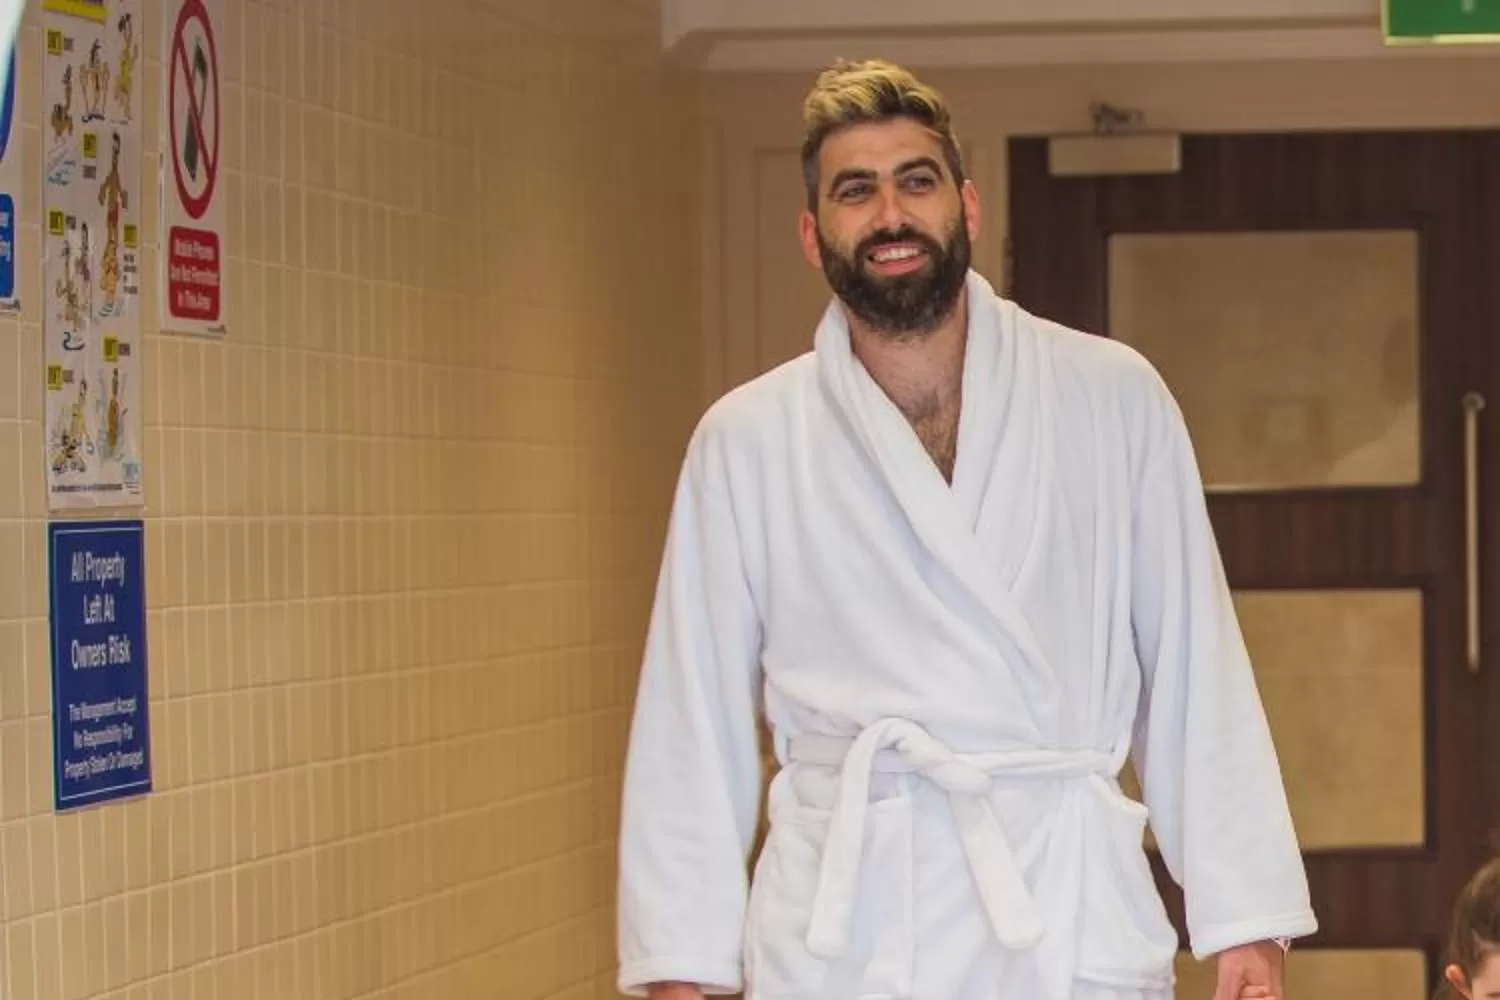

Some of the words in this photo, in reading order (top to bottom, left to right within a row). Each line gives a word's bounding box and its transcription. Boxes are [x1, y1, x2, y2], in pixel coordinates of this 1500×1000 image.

[71, 551, 84, 582] All
[85, 551, 125, 588] Property
[84, 594, 102, 624] Left
[103, 592, 115, 623] At
[71, 640, 107, 669] Owners
[108, 634, 131, 664] Risk
